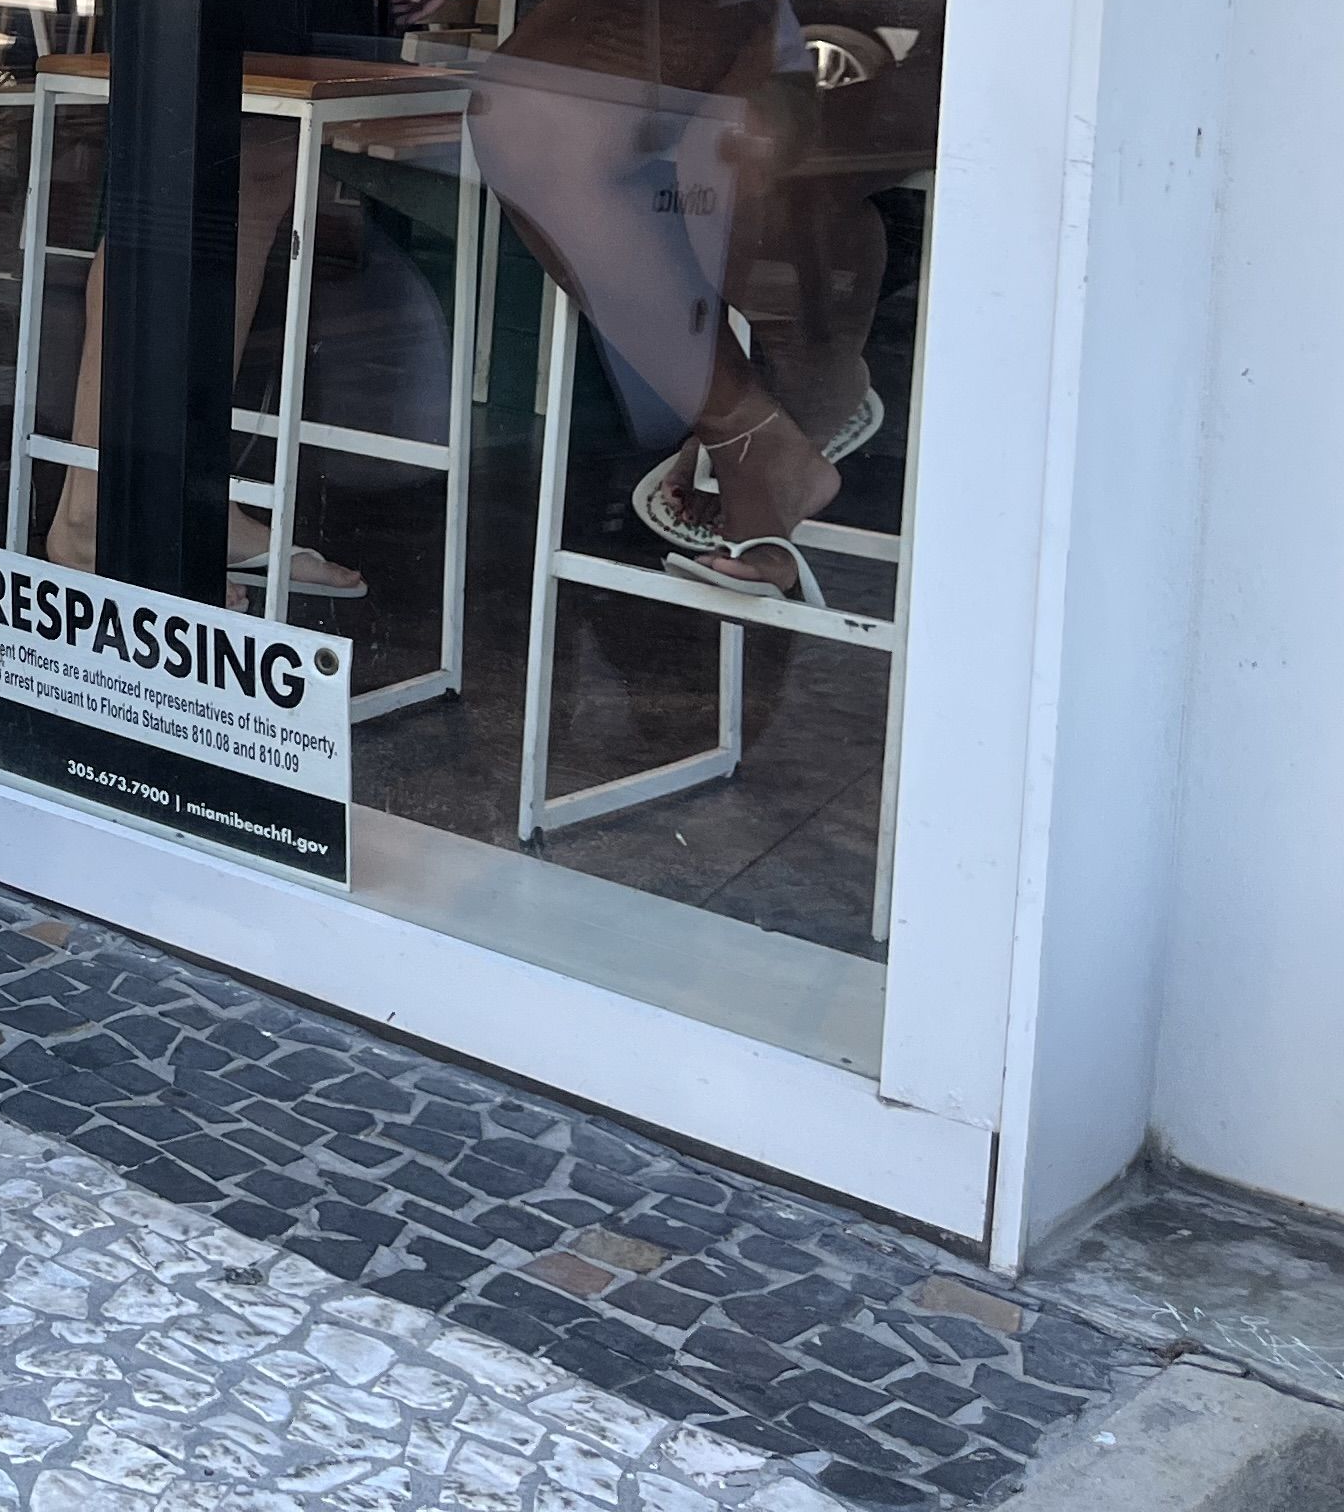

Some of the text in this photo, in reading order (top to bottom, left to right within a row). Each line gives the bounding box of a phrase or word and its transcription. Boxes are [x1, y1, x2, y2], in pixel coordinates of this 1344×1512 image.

[4, 669, 34, 693] arrest
[37, 677, 85, 709] pursuant
[86, 692, 98, 712] to
[100, 699, 140, 726] Florida
[142, 709, 189, 741] Statutes
[191, 724, 230, 753] 810.08
[232, 739, 256, 761] and
[259, 745, 300, 774] 810.09
[18, 644, 60, 674] Officers
[62, 661, 80, 680] are
[82, 667, 141, 700] authorized
[144, 686, 234, 727] representatives
[238, 711, 251, 730] of
[254, 715, 277, 739] this
[280, 727, 338, 760] property.
[67, 759, 170, 806] 305.673.7900
[186, 800, 329, 855] miamibeachfl.gov
